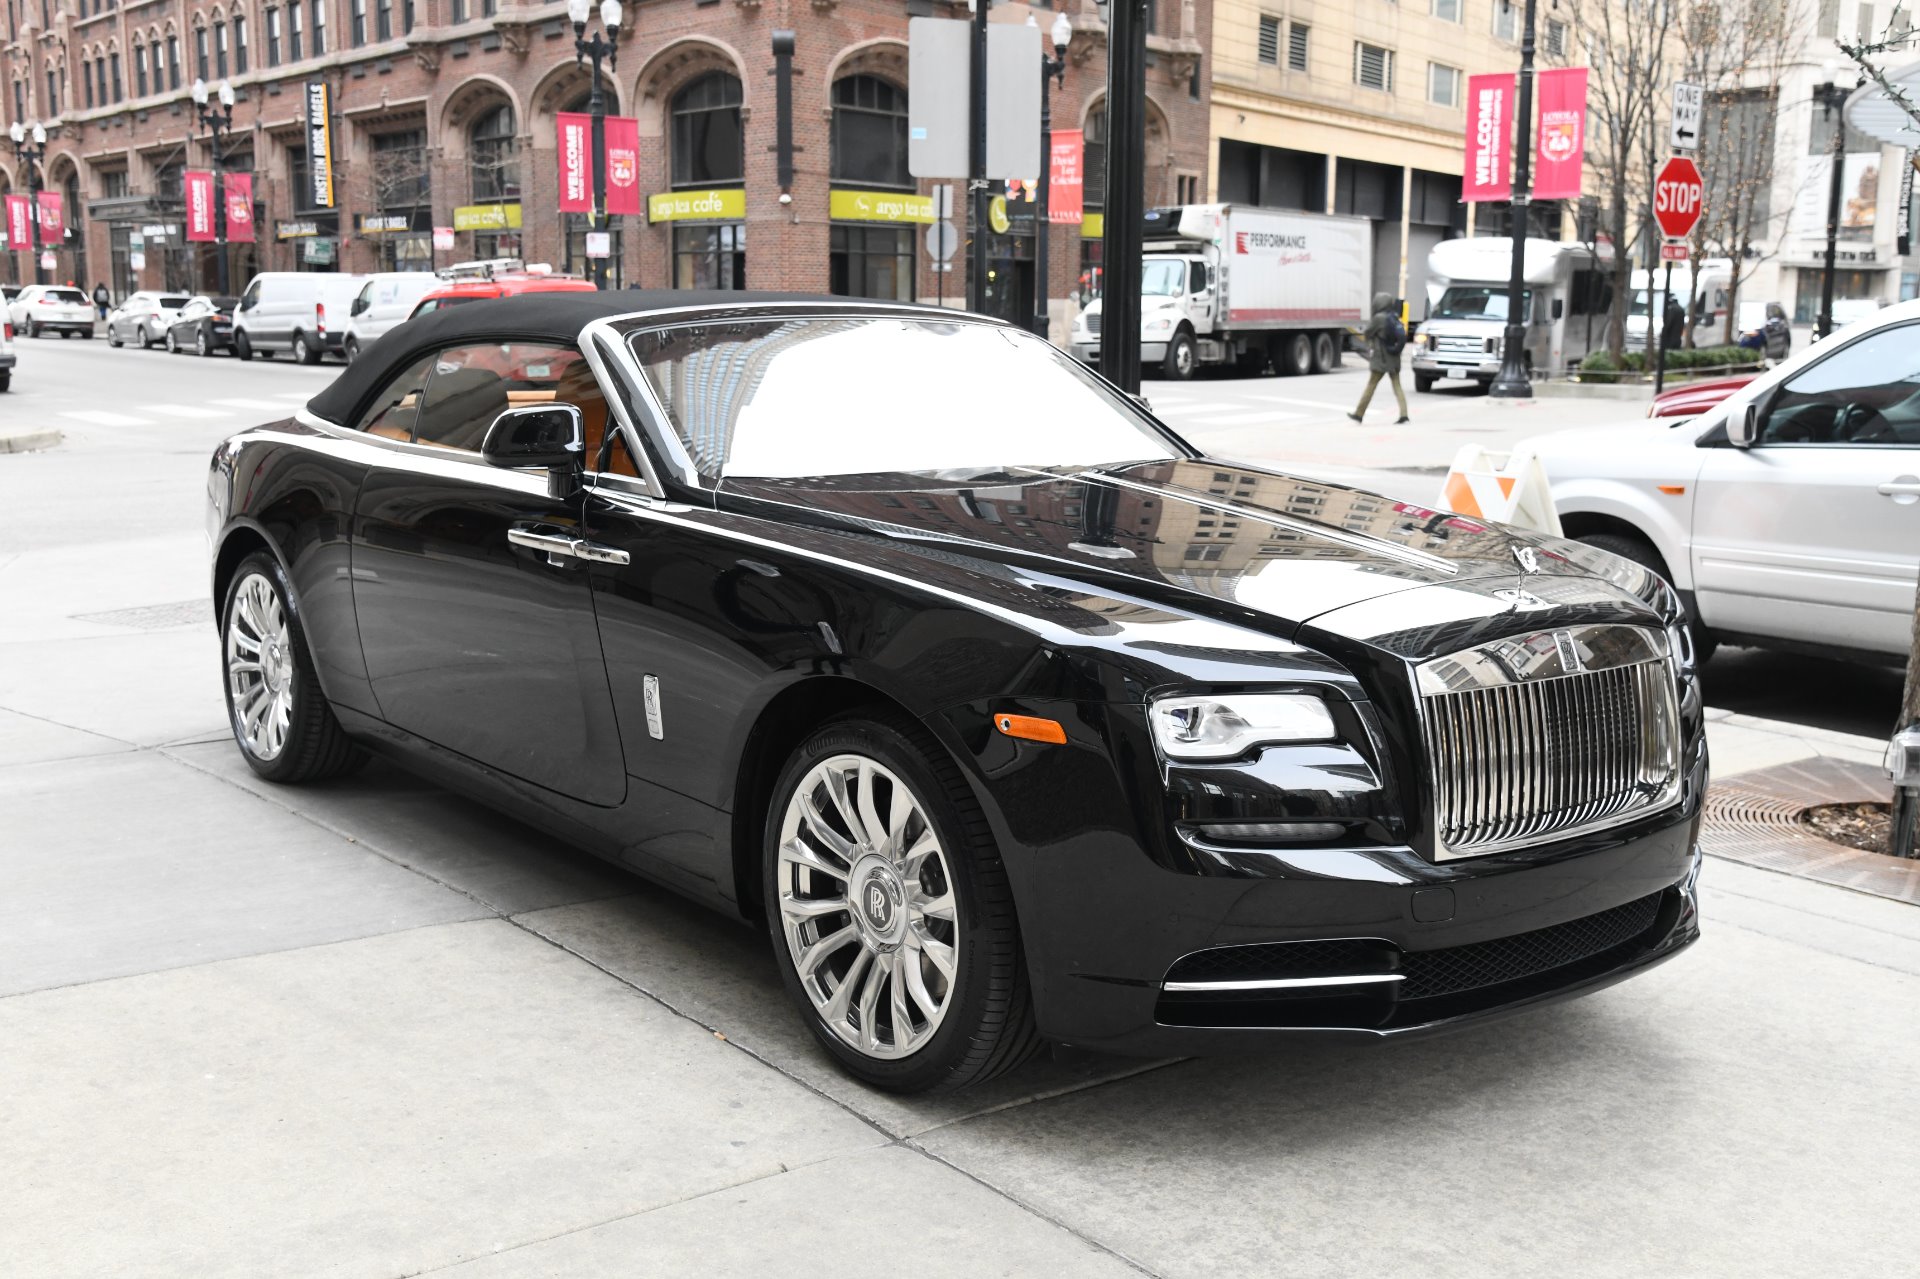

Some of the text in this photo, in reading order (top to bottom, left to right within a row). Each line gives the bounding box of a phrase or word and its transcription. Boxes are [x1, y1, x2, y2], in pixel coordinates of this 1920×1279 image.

[309, 84, 325, 125] BAGELS
[1676, 87, 1699, 106] ONE
[1542, 110, 1580, 121] LOYOLA
[1675, 106, 1698, 122] WAY
[1475, 88, 1494, 186] WELCOME
[565, 124, 579, 201] WELCOME
[313, 157, 328, 206] EINSTEIN
[191, 180, 204, 233] WELCOME
[693, 191, 723, 213] café
[876, 201, 903, 219] argo
[905, 201, 919, 217] tea
[1656, 180, 1701, 214] STOP
[1250, 232, 1306, 249] PERFORMANCE
